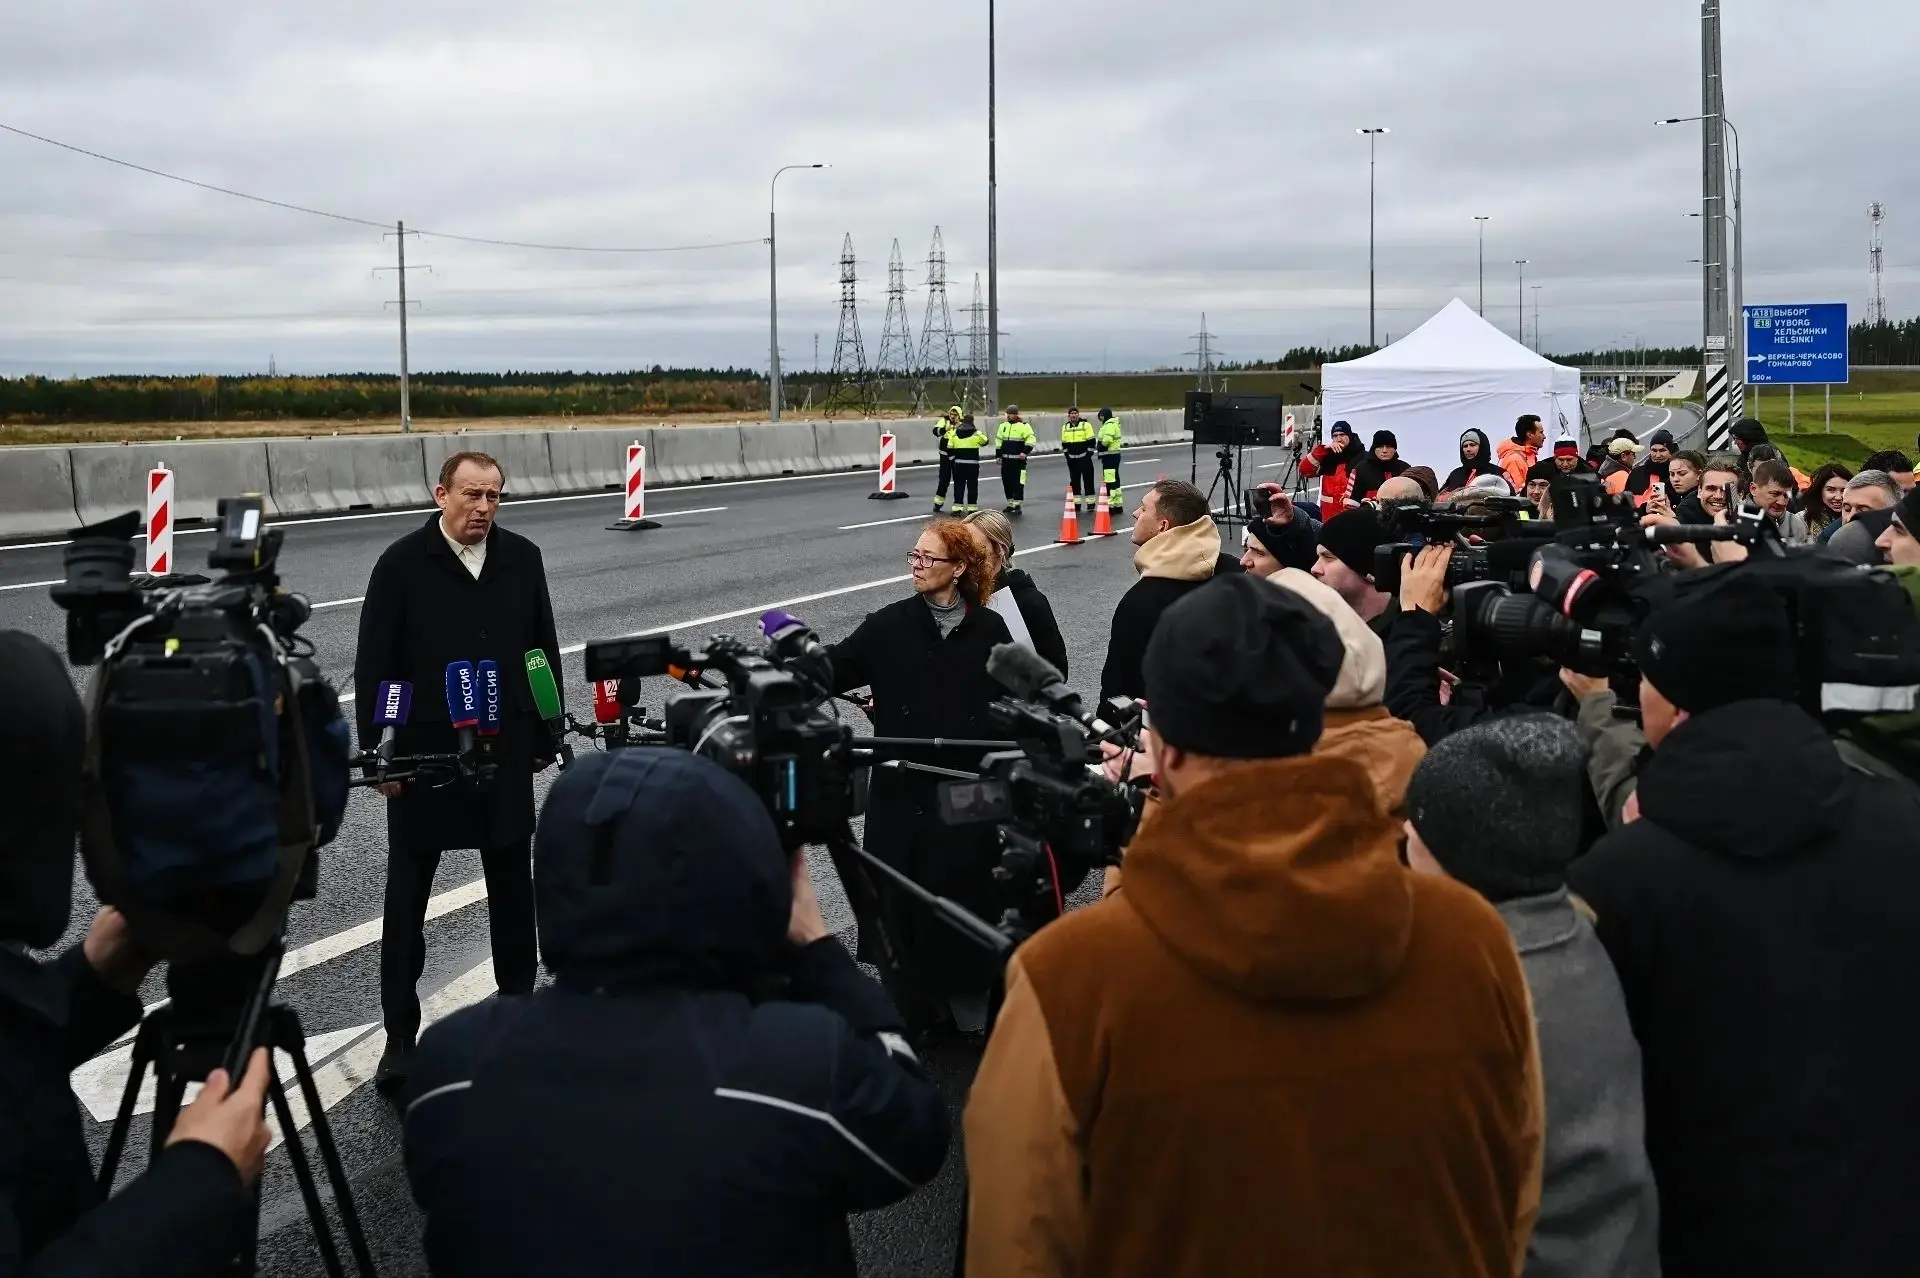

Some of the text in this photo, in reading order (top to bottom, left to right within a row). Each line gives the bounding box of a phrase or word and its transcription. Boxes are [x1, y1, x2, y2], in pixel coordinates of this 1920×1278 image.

[1774, 308, 1810, 317] ВЫБОРГ
[1774, 319, 1810, 327] VYBORG
[1774, 328, 1827, 336] ХЕЛЬСИНКИ
[1774, 336, 1813, 344] HELSINKI
[1767, 352, 1843, 360] ВЕРХНЕ-ЧЕРКАСОВО
[528, 656, 546, 671] НТВ
[459, 668, 475, 711] РОССИЯ
[486, 670, 498, 721] РОССИЯ
[384, 683, 402, 719] ИЗВЕСТИЯ
